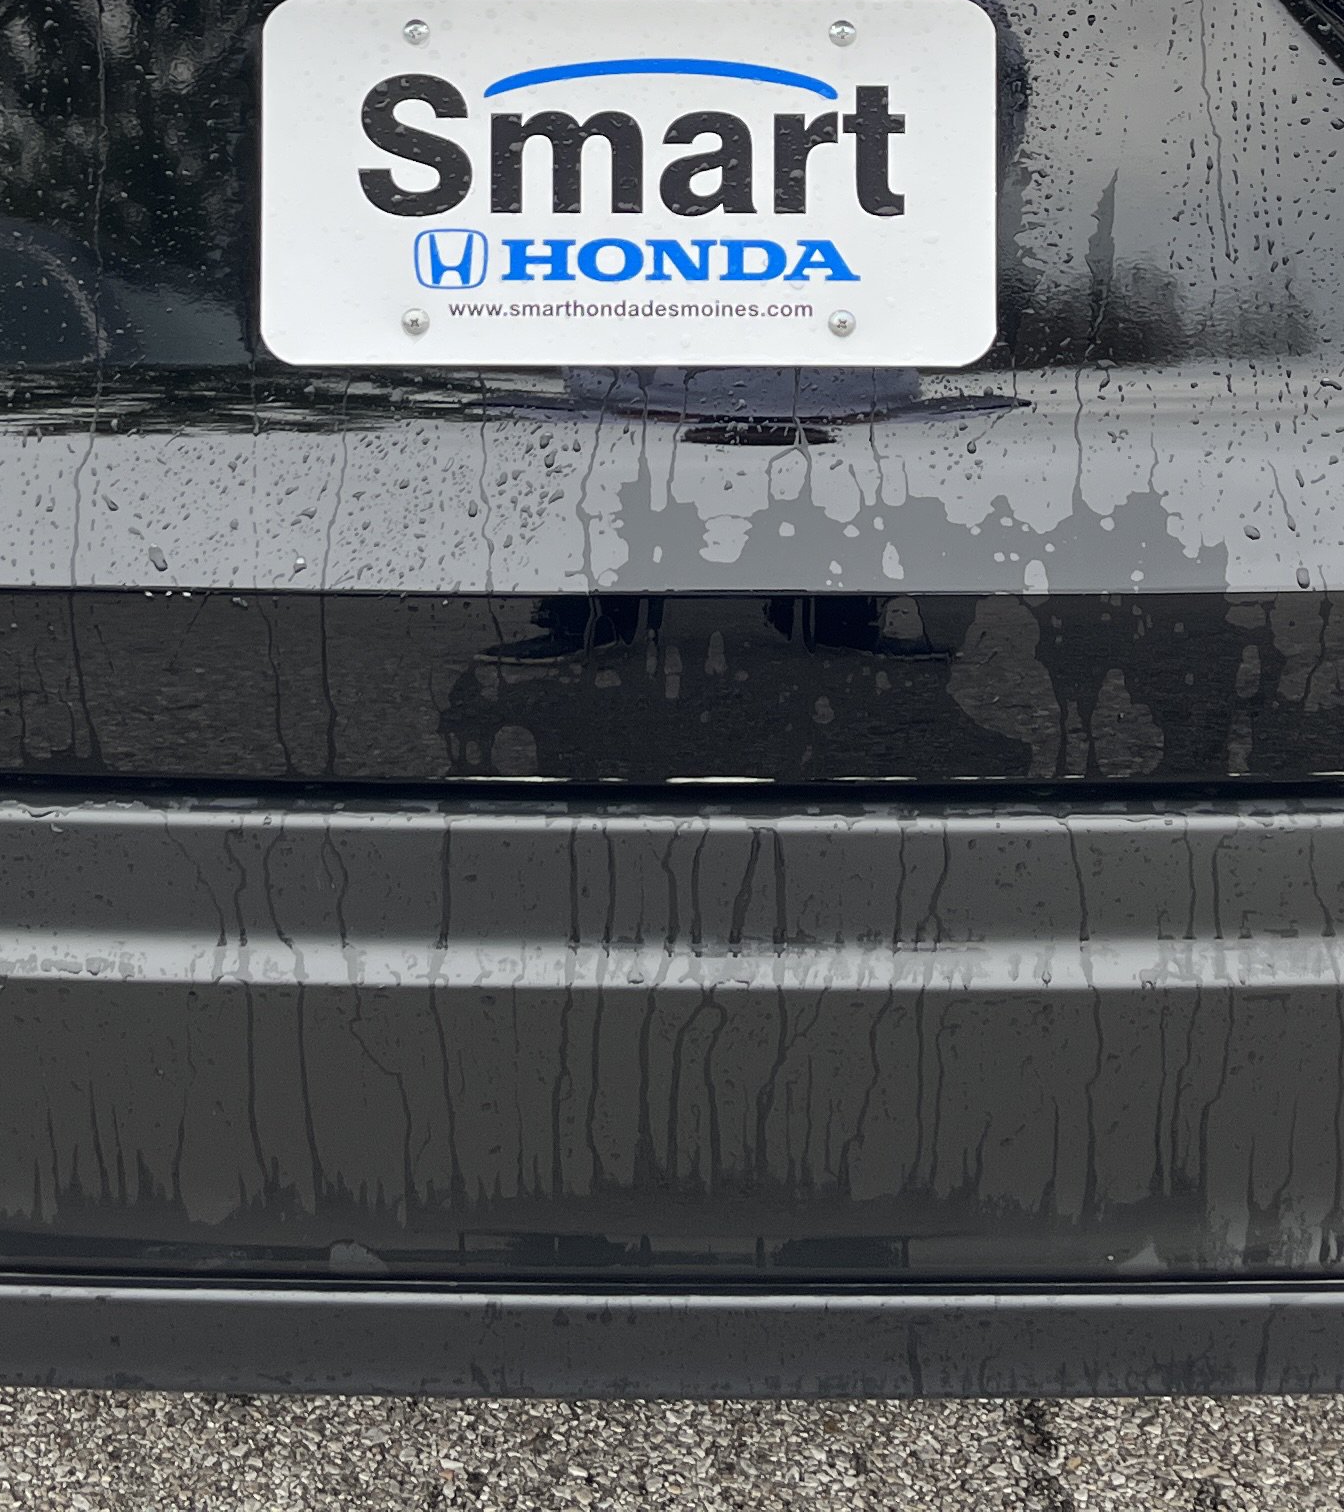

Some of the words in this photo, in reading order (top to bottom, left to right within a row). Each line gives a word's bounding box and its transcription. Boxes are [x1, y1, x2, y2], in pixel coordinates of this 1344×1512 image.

[357, 73, 907, 217] Smart
[501, 238, 862, 282] HONDA
[448, 299, 814, 320] www.smarthondadesmoines.com
